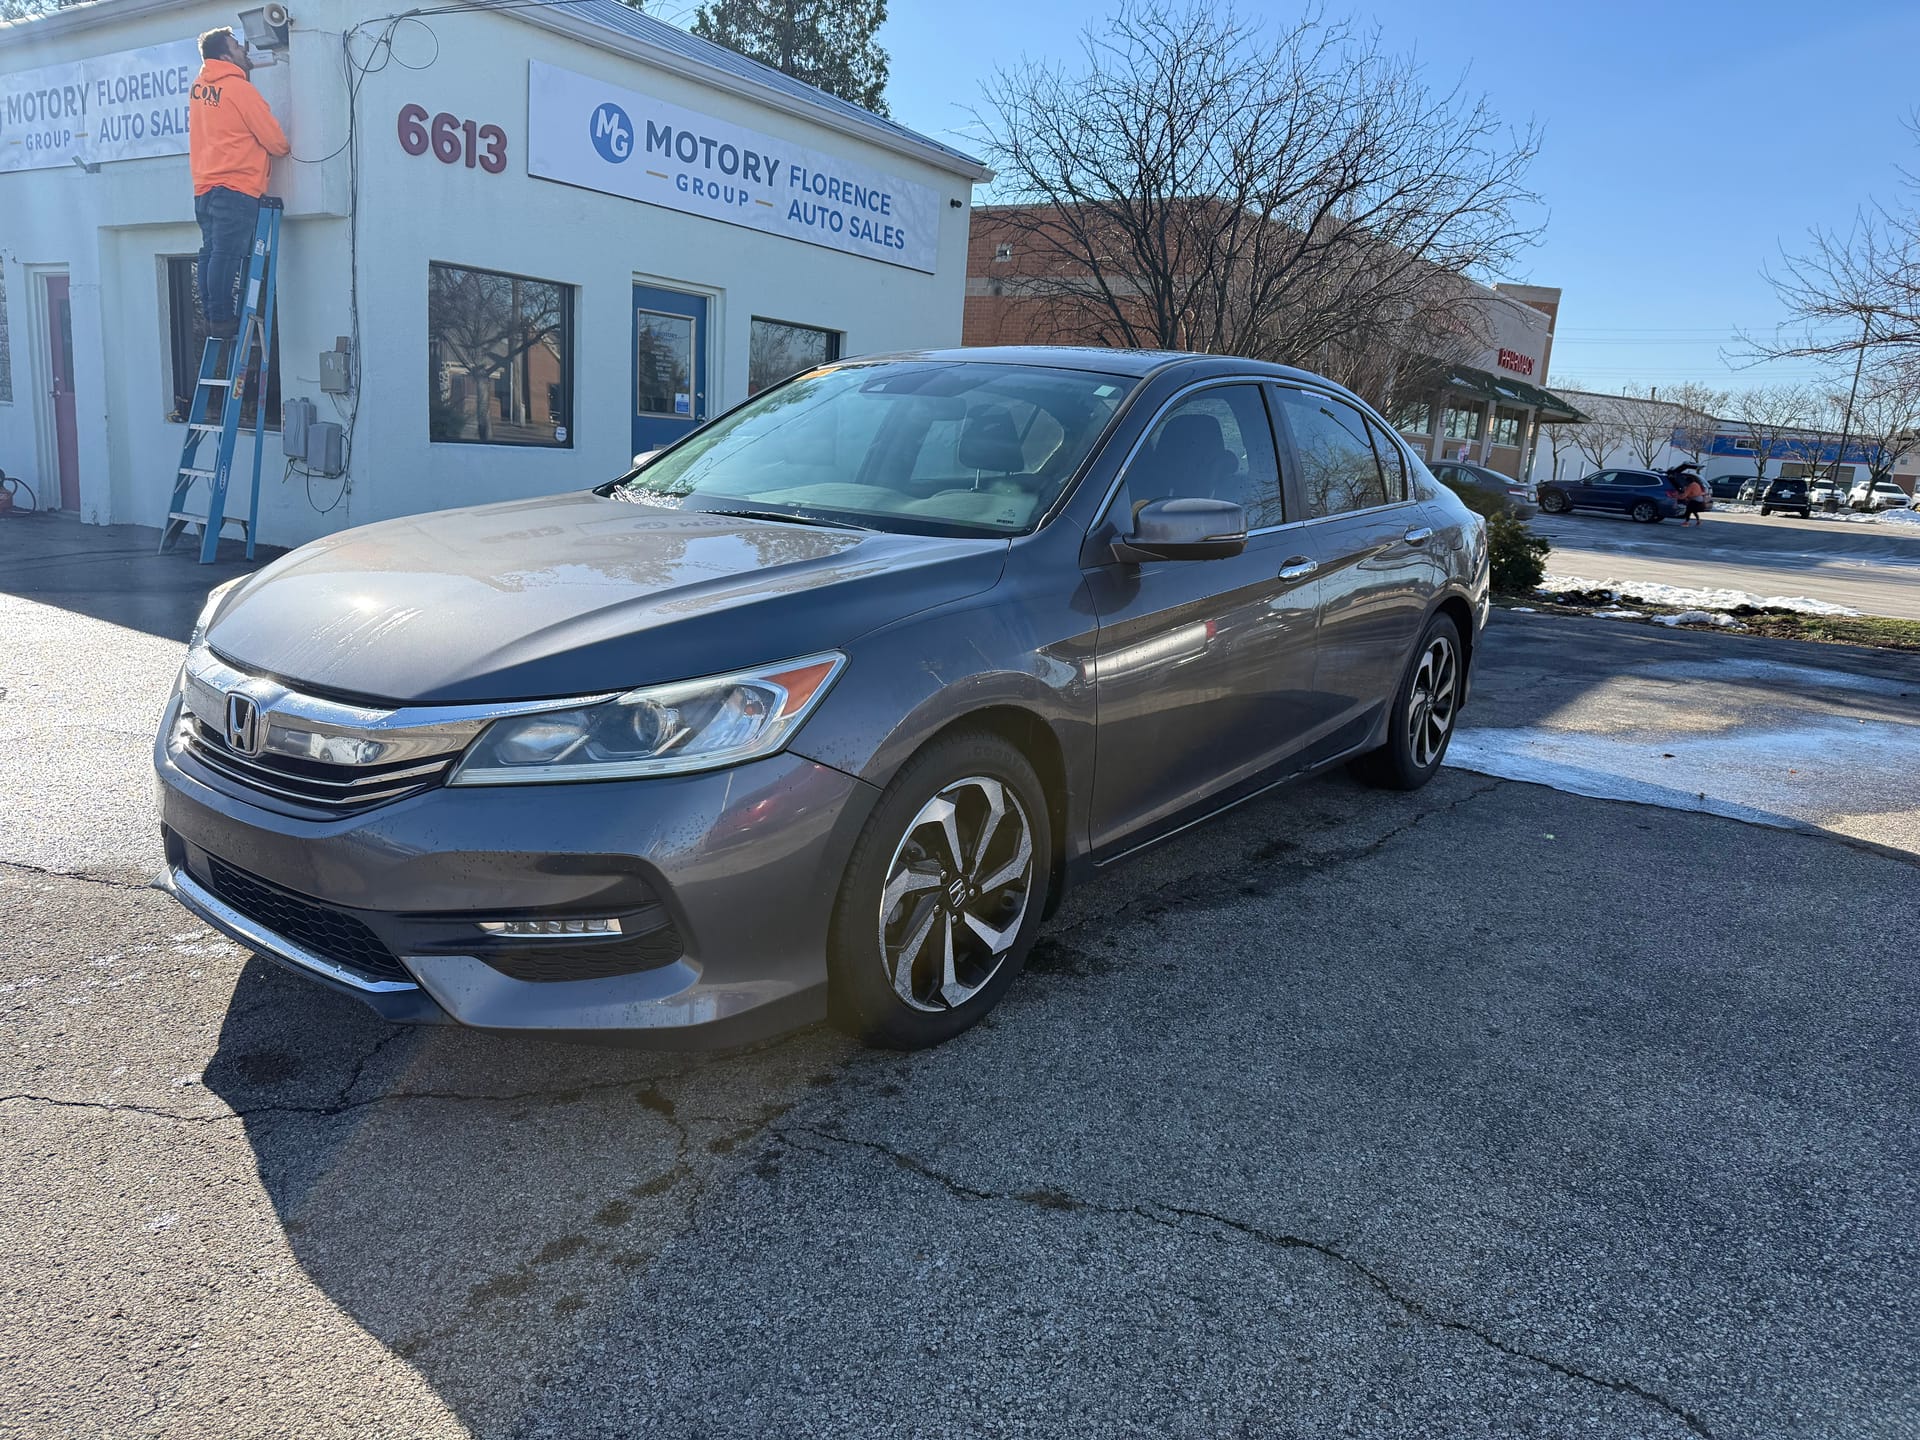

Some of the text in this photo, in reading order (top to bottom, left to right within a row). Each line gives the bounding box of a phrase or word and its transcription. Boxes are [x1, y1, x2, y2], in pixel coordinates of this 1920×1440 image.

[7, 82, 90, 125] MOTORY
[97, 65, 190, 107] FLORENCE
[25, 129, 71, 151] GROUP
[99, 105, 190, 144] AUTO SALE
[397, 103, 508, 174] 6613
[596, 108, 630, 158] MG
[646, 119, 780, 187] MOTORY
[675, 173, 749, 207] GROUP
[789, 164, 892, 216] FLORENCE
[787, 198, 905, 250] AUTO SALES
